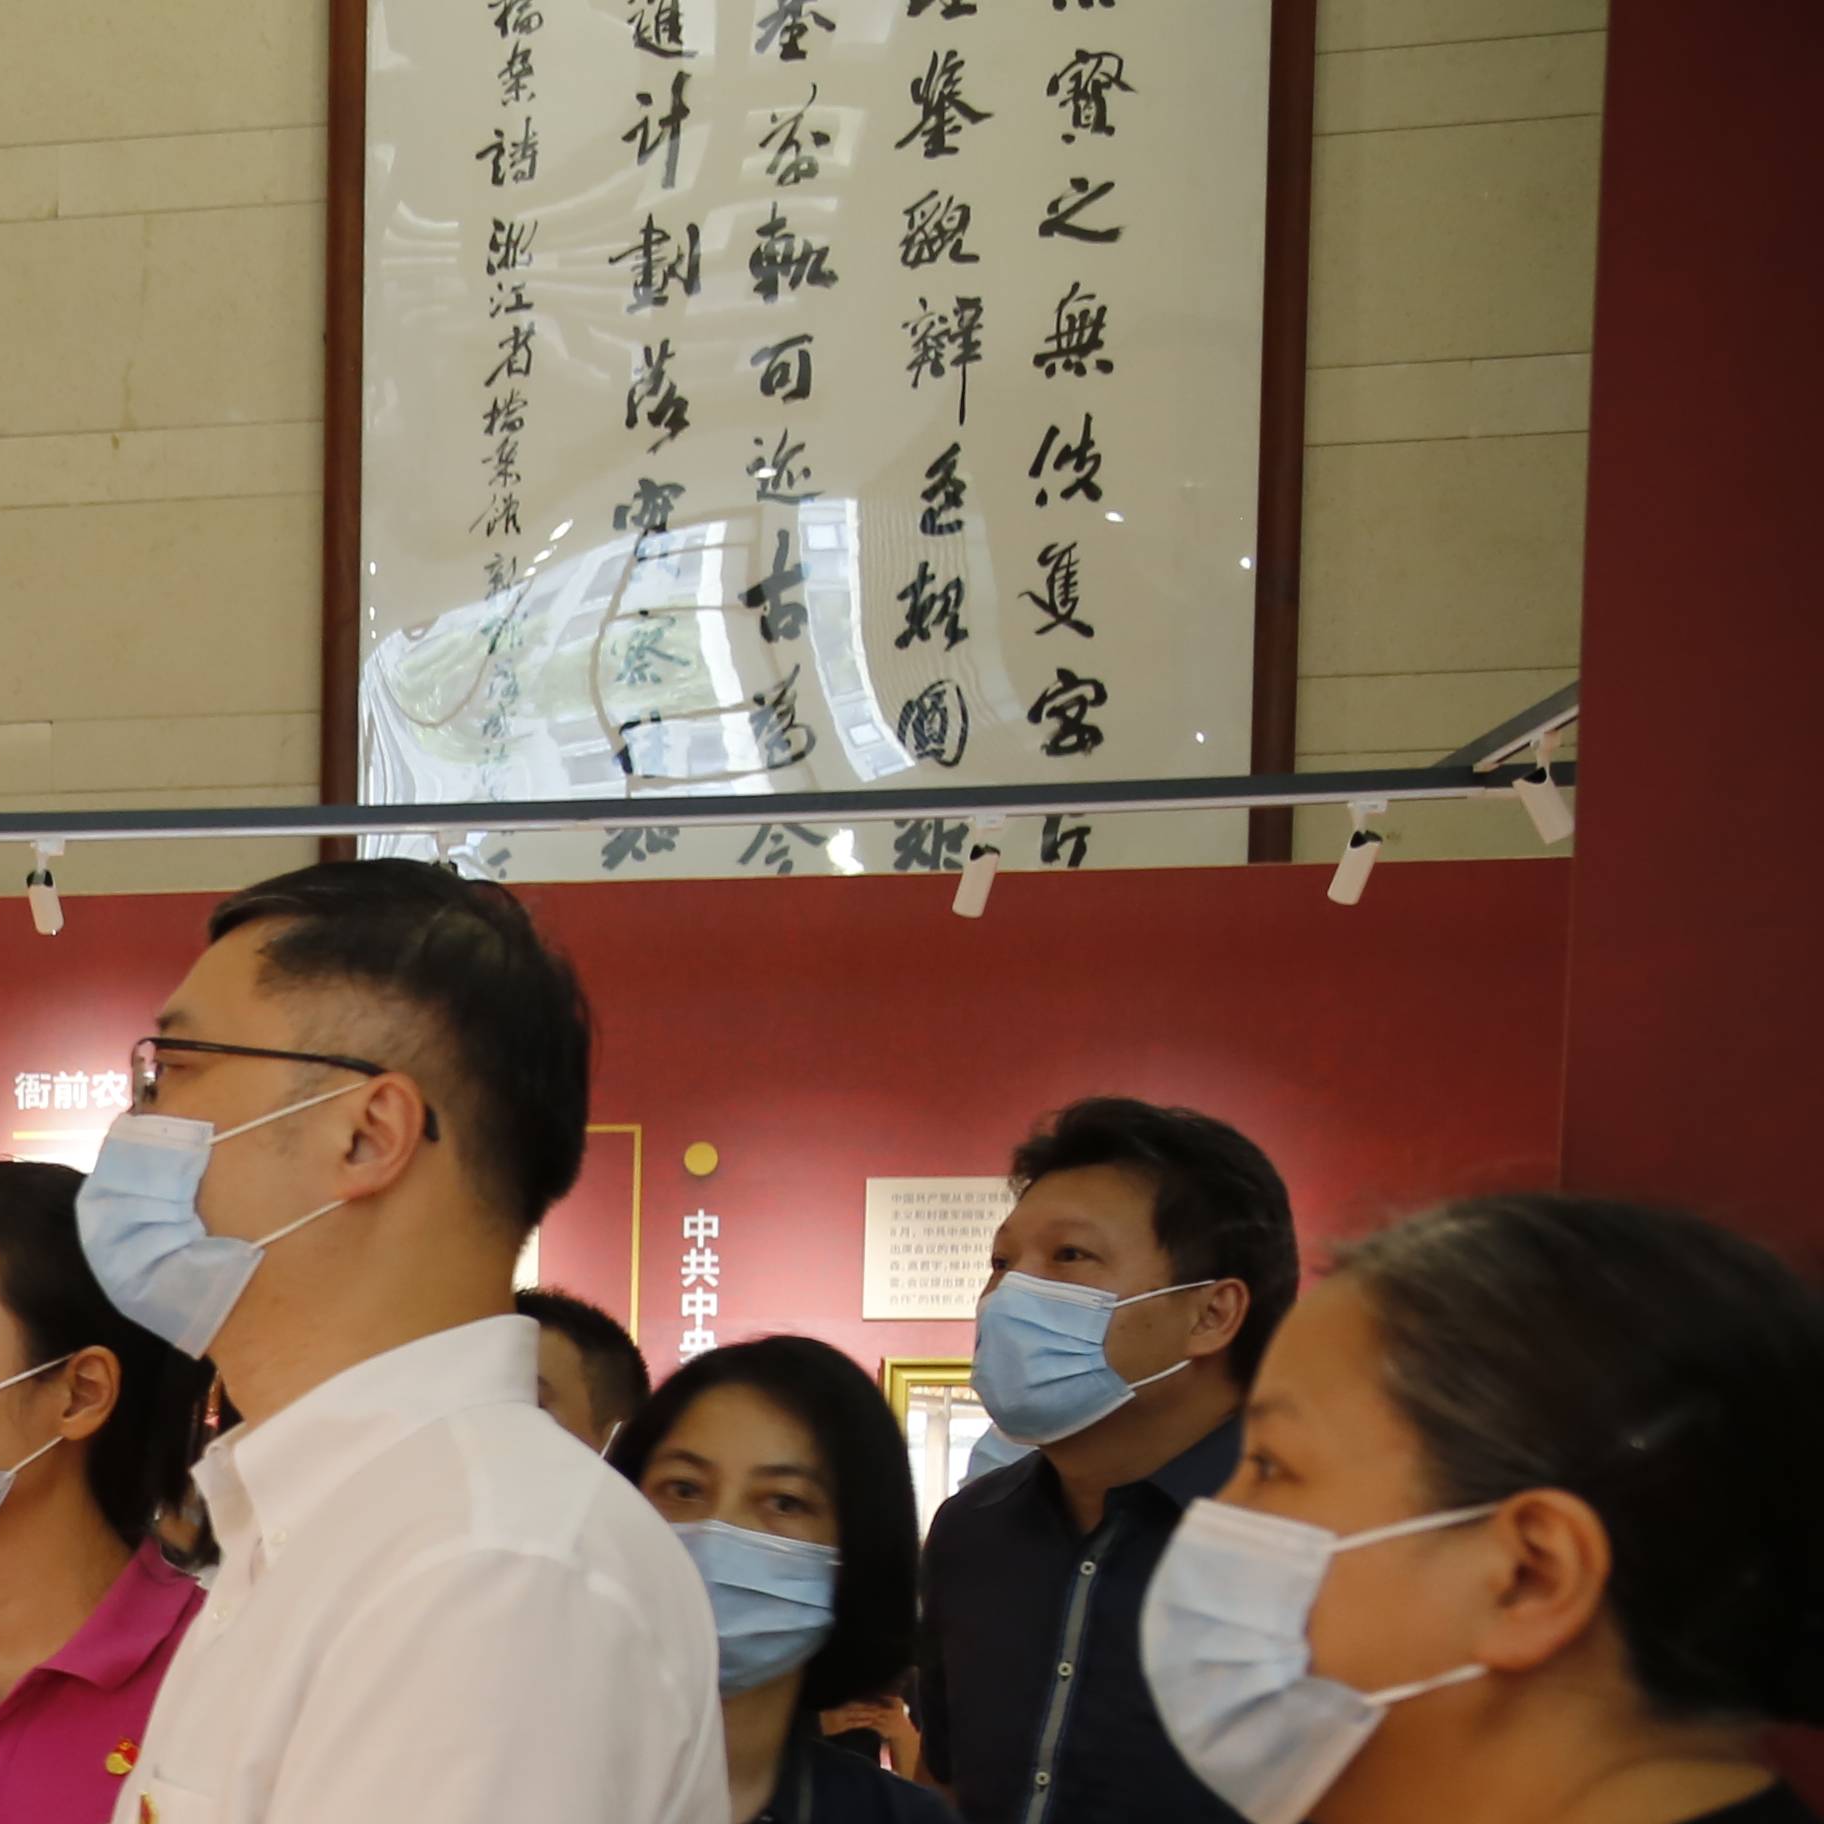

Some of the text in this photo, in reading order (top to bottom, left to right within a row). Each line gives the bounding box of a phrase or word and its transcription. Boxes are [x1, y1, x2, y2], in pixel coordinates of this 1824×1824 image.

[13, 1070, 129, 1111] 衙前农
[679, 1208, 720, 1365] 中共中央
